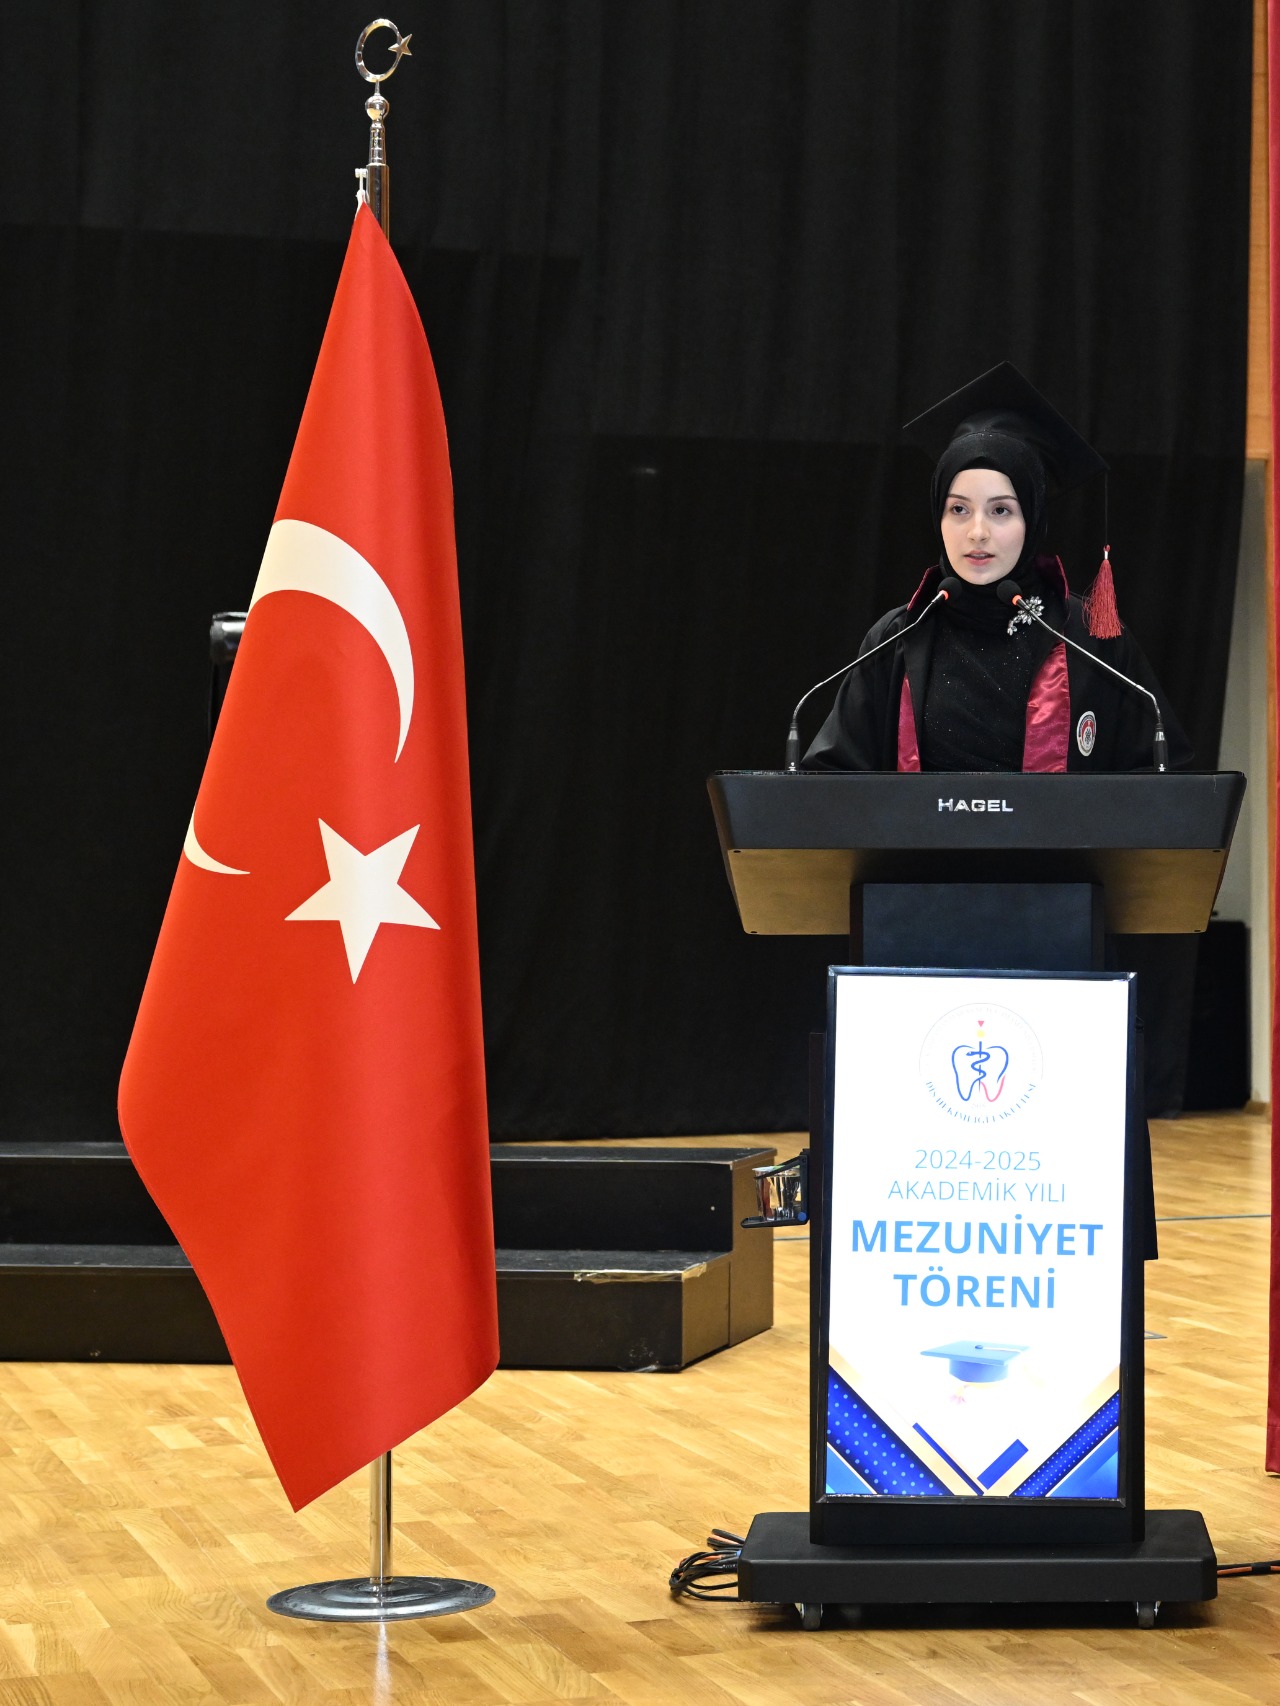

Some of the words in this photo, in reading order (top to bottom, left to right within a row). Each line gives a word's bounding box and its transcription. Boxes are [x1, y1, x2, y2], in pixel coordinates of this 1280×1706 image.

[938, 798, 1014, 812] HAGEL
[915, 1149, 1042, 1171] 2024-2025
[887, 1177, 1017, 1202] AKADEMİK
[1025, 1182, 1065, 1203] YILI
[851, 1213, 1104, 1256] MEZUNİYET
[893, 1265, 1056, 1309] TÖRENİ
